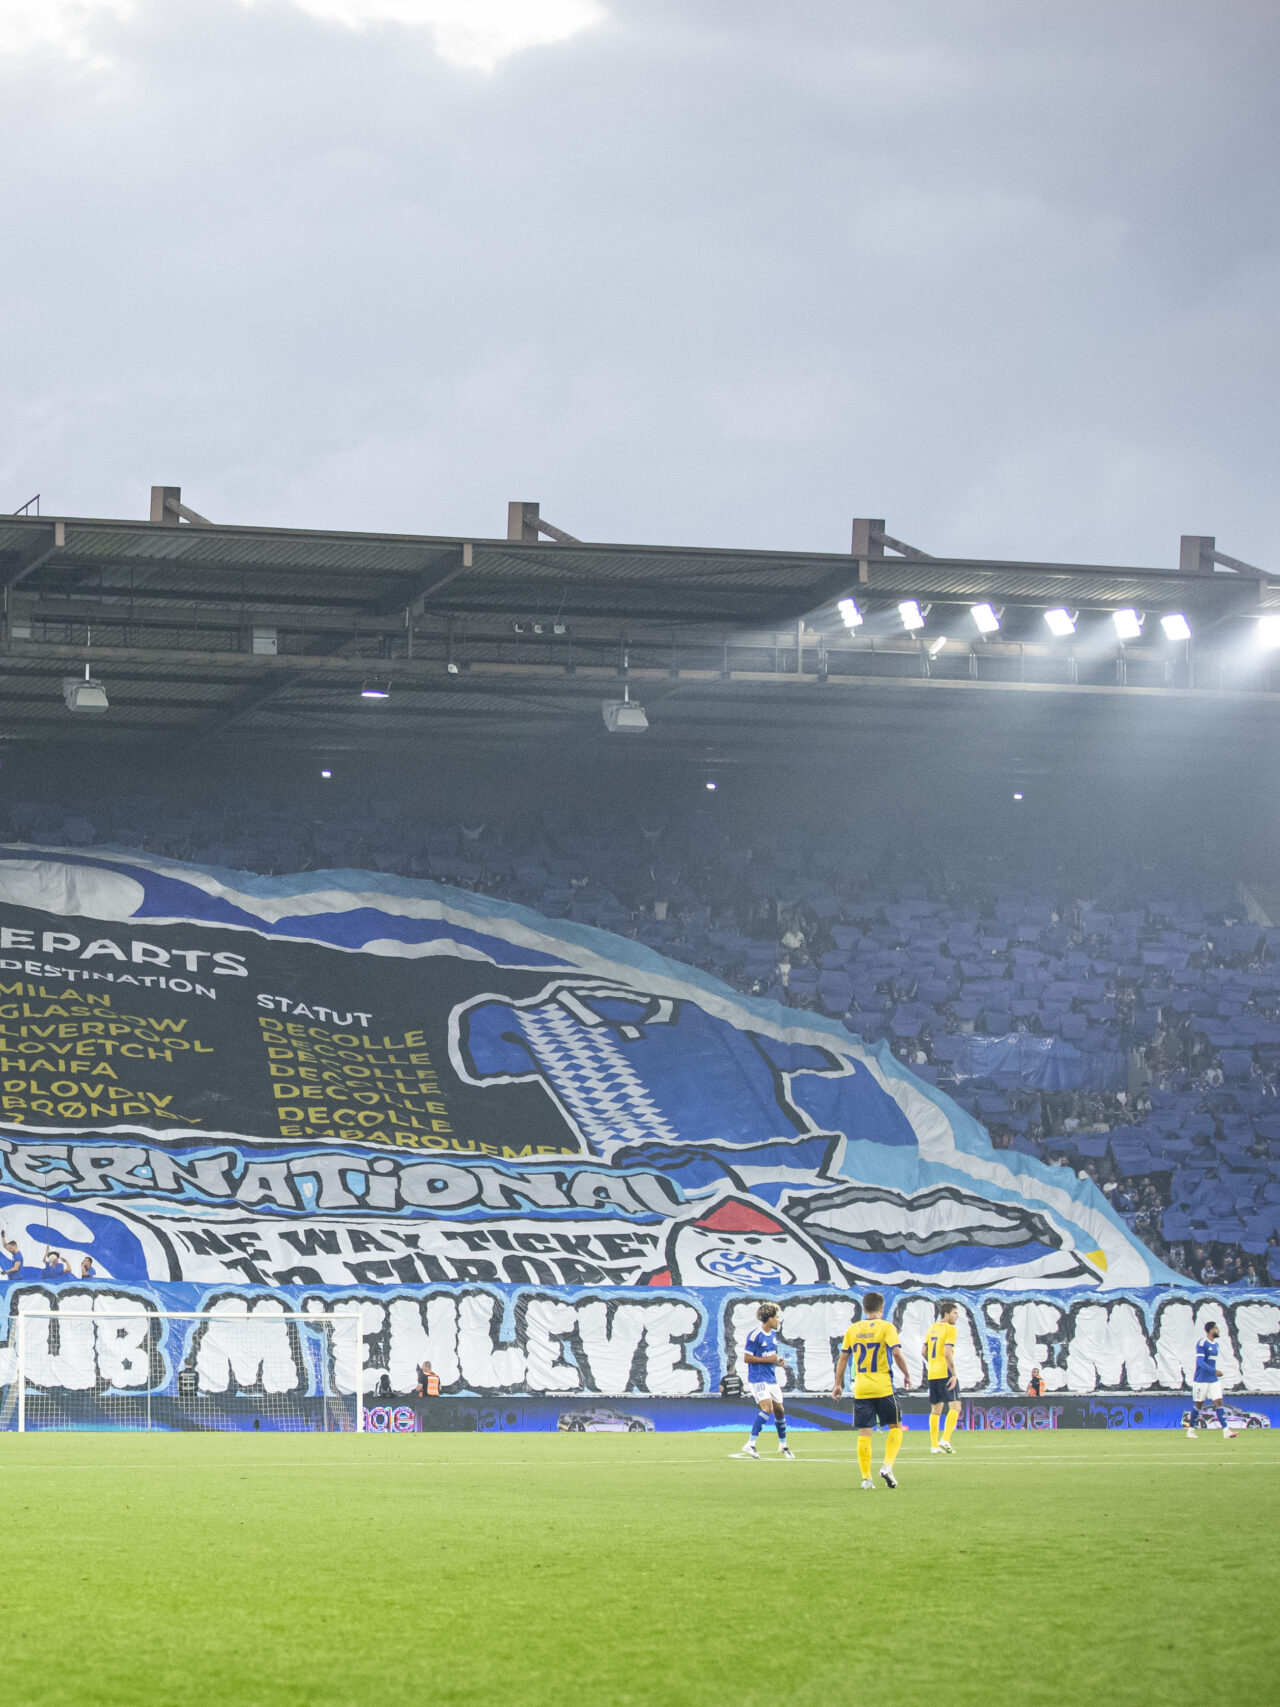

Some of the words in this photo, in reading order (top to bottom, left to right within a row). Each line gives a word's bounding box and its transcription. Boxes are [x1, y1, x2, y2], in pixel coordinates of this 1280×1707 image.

[0, 959, 216, 1000] DESTINATION
[256, 994, 372, 1027] STATUT
[258, 1017, 427, 1049] DECOLLE
[262, 1031, 432, 1065] DECOLLE
[0, 1038, 173, 1062] LOVETCH
[268, 1047, 438, 1079] DECOLLE
[1, 1057, 119, 1079] HAIFA
[269, 1063, 442, 1094] DECOLLE
[273, 1083, 449, 1115] DECOLLE
[278, 1106, 454, 1132] DECOLLE
[178, 1229, 272, 1262] NE
[278, 1228, 423, 1256] WAY
[195, 1298, 704, 1395] M'ENLEVE
[853, 1342, 880, 1373] 27
[931, 1336, 938, 1358] 7
